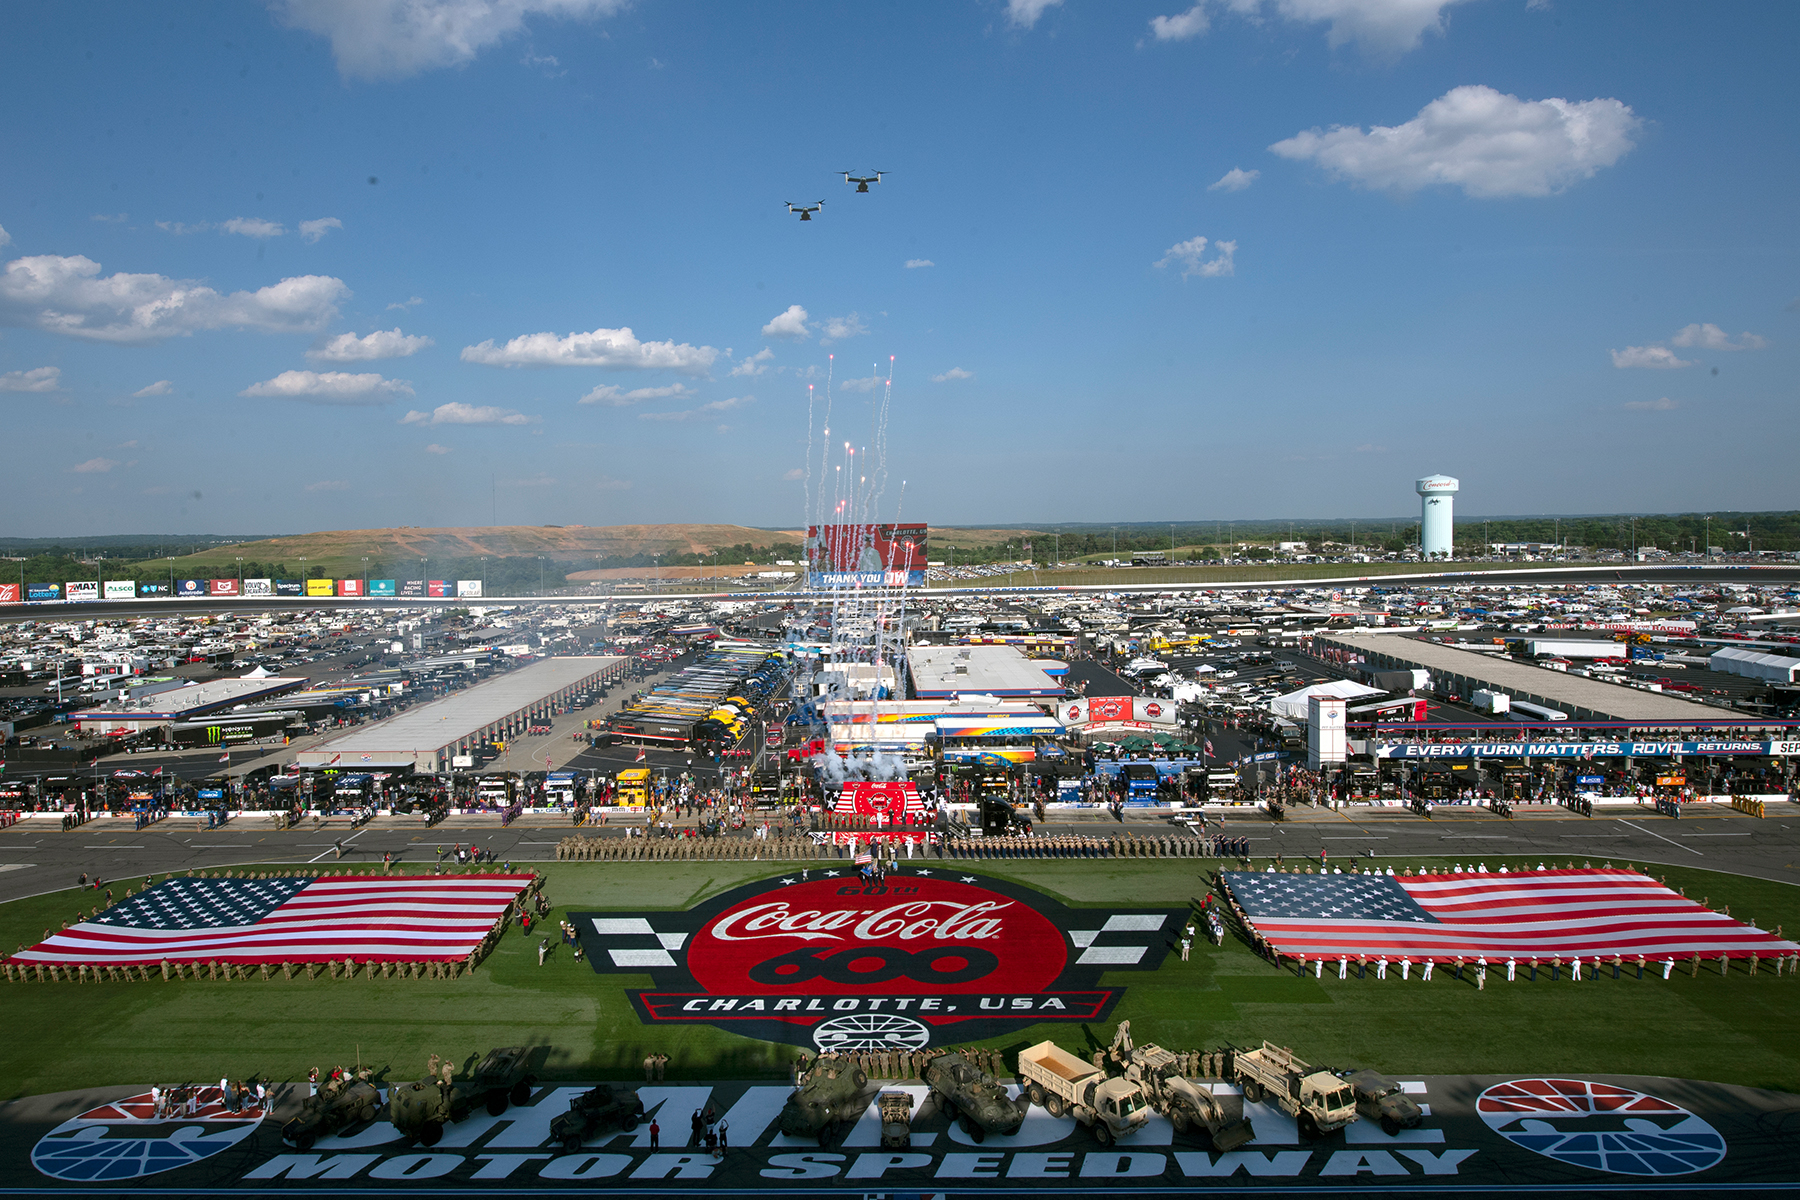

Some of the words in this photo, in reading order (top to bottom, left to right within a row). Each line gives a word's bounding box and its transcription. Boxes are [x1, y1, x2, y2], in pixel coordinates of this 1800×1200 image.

[823, 574, 858, 584] THANK
[861, 574, 881, 583] YOU
[1406, 746, 1467, 755] EVERY
[1471, 745, 1523, 755] TURN
[1528, 745, 1623, 755] MATTERS.
[836, 886, 919, 896] 60TH
[711, 900, 1016, 941] Coca-Cola
[749, 946, 999, 984] 600
[682, 997, 957, 1013] CHARLOTTE,
[979, 997, 1067, 1010] USA
[241, 1153, 724, 1180] MOTOR
[760, 1149, 1480, 1180] SPEEDWAY
